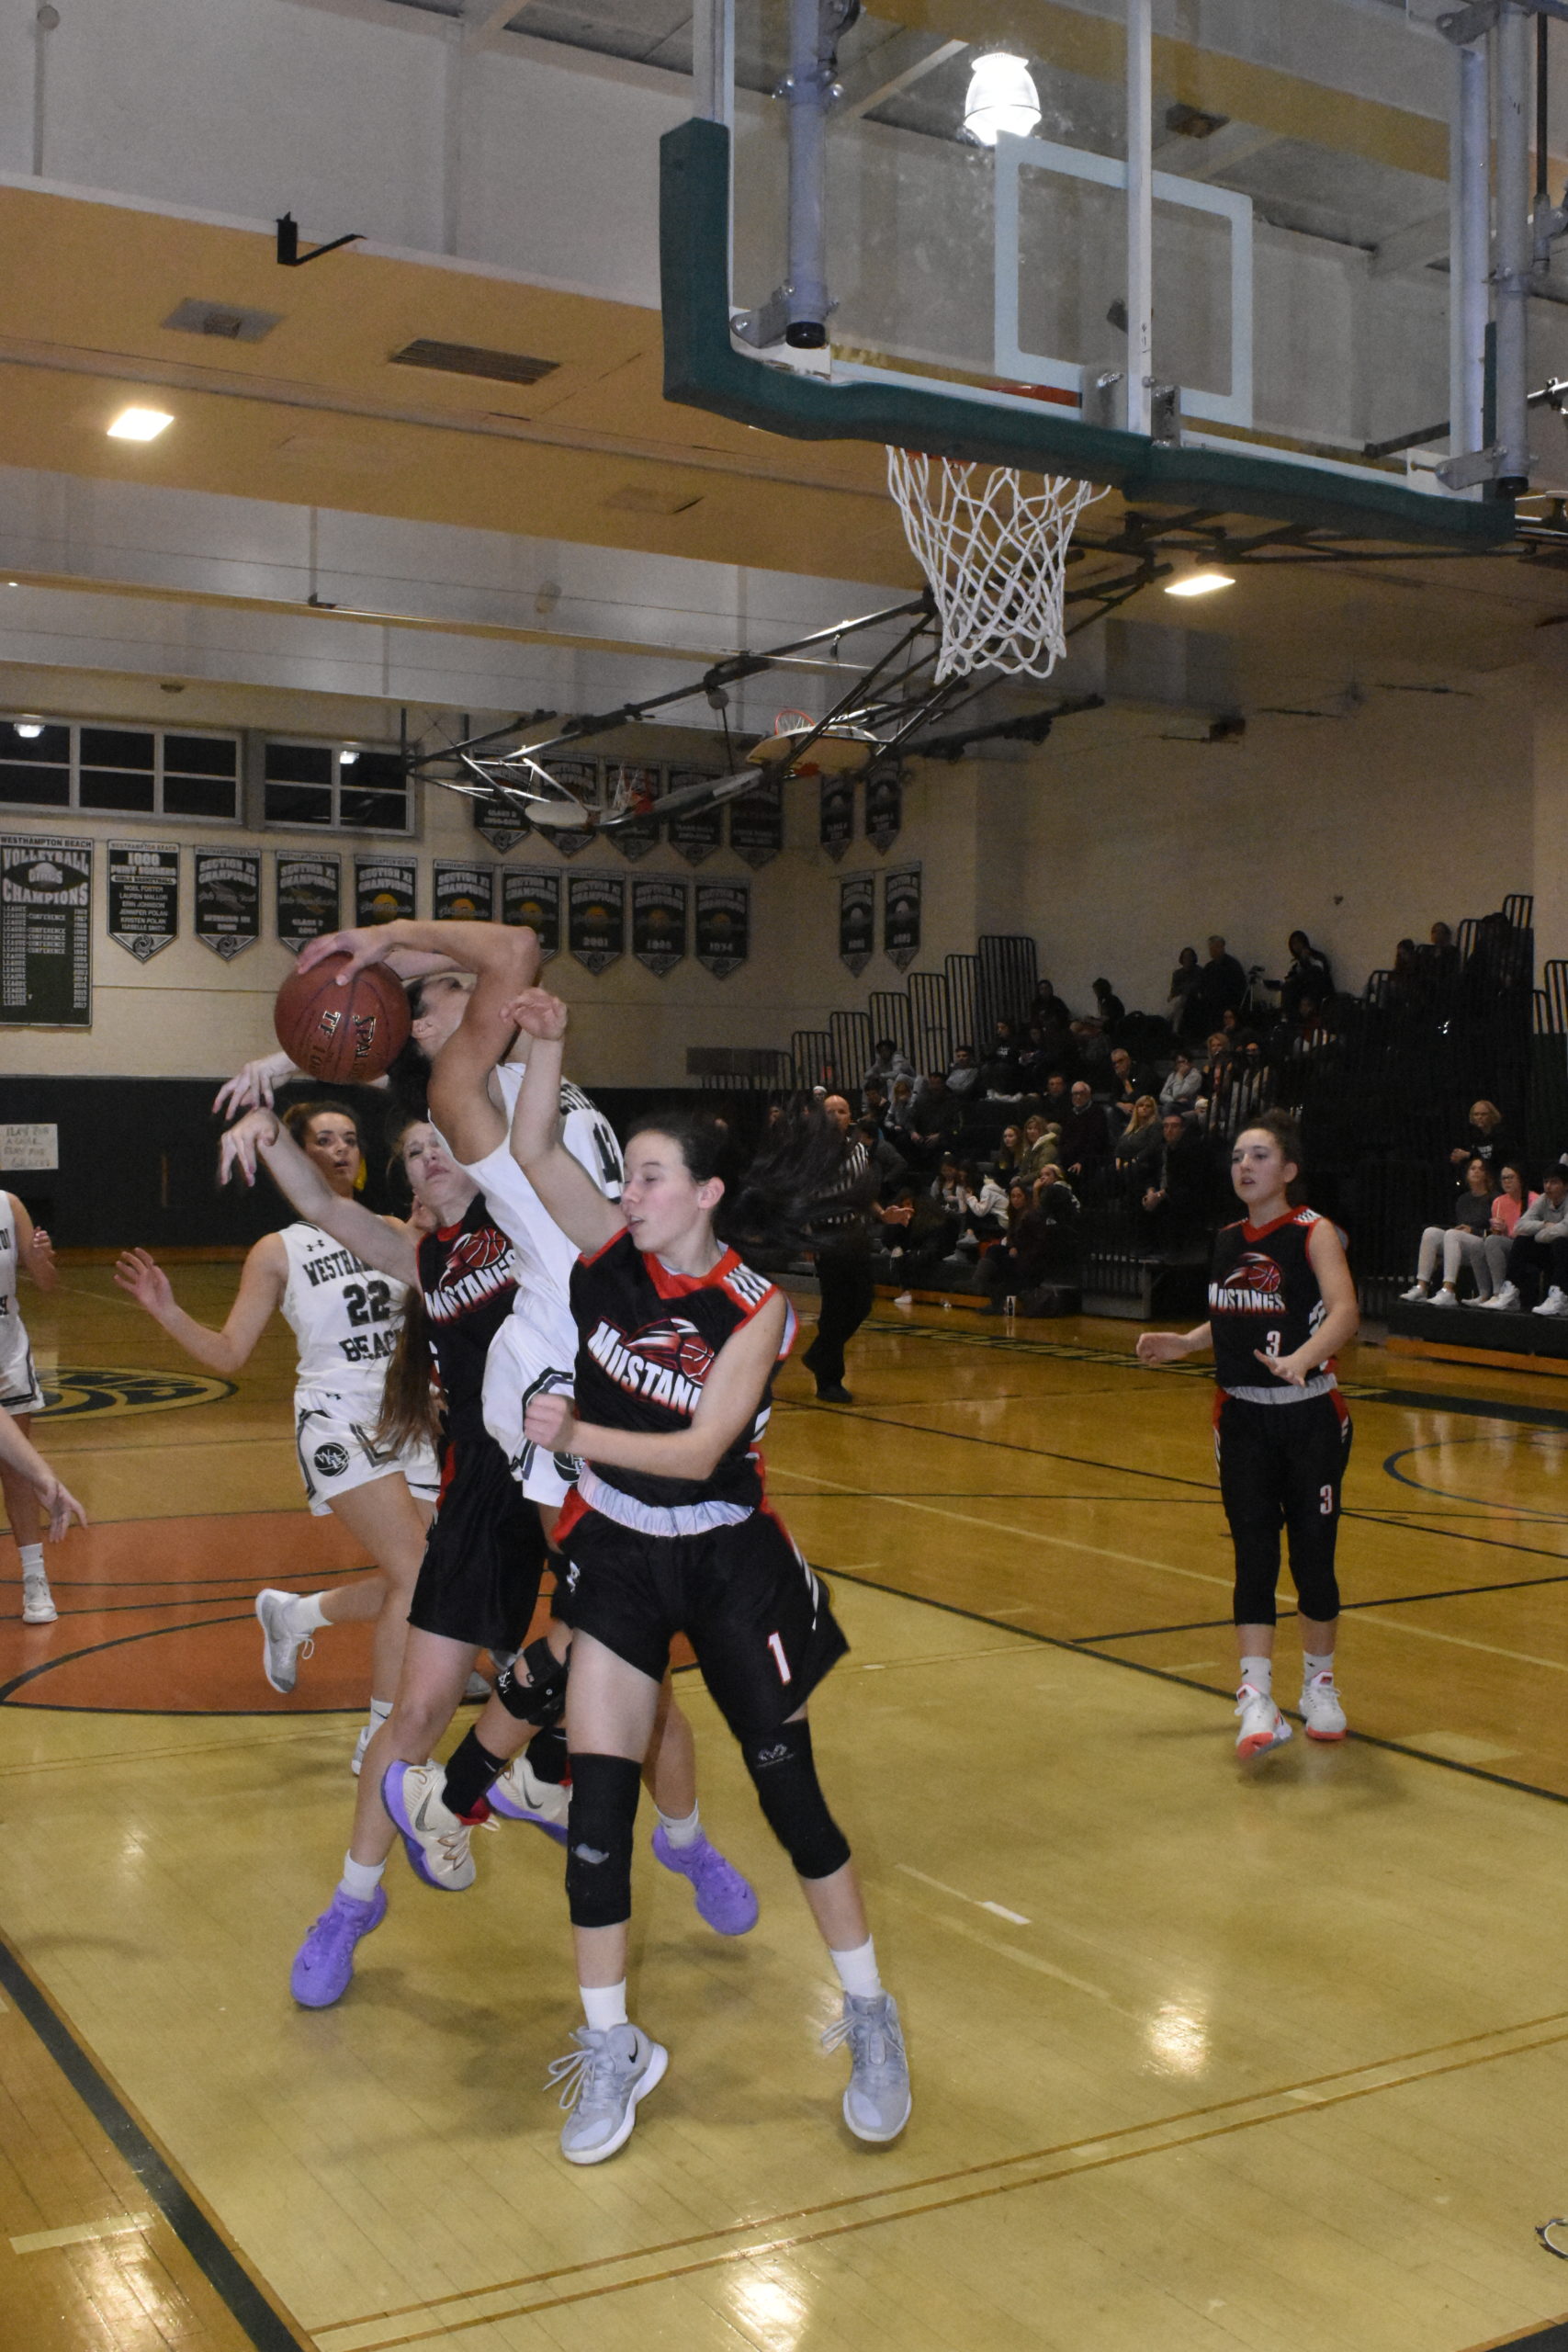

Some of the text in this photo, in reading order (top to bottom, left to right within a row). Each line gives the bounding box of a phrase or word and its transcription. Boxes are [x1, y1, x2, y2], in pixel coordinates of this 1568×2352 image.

[1, 836, 62, 846] WESTHAMPTON
[3, 848, 89, 876] VOLLEYBALL
[128, 852, 161, 866] 1000
[199, 858, 243, 872] SECTION
[110, 865, 176, 876] POINT SCORERS
[198, 868, 256, 887] CHAMPIONS
[359, 867, 400, 881] SECTION
[438, 872, 478, 886] SECTION
[3, 877, 88, 906] CHAMPIONS
[279, 873, 337, 891] CHAMPIONS
[358, 877, 413, 896] CHAMPIONS
[437, 882, 491, 899] CHAMPIONS
[319, 1011, 341, 1036] TF
[343, 1280, 390, 1328] 22
[1208, 1282, 1287, 1314] MUSTANGS
[338, 1329, 401, 1362] BEAC
[1266, 1330, 1280, 1360] 3
[1320, 1484, 1333, 1514] 3
[767, 1631, 792, 1686] 1
